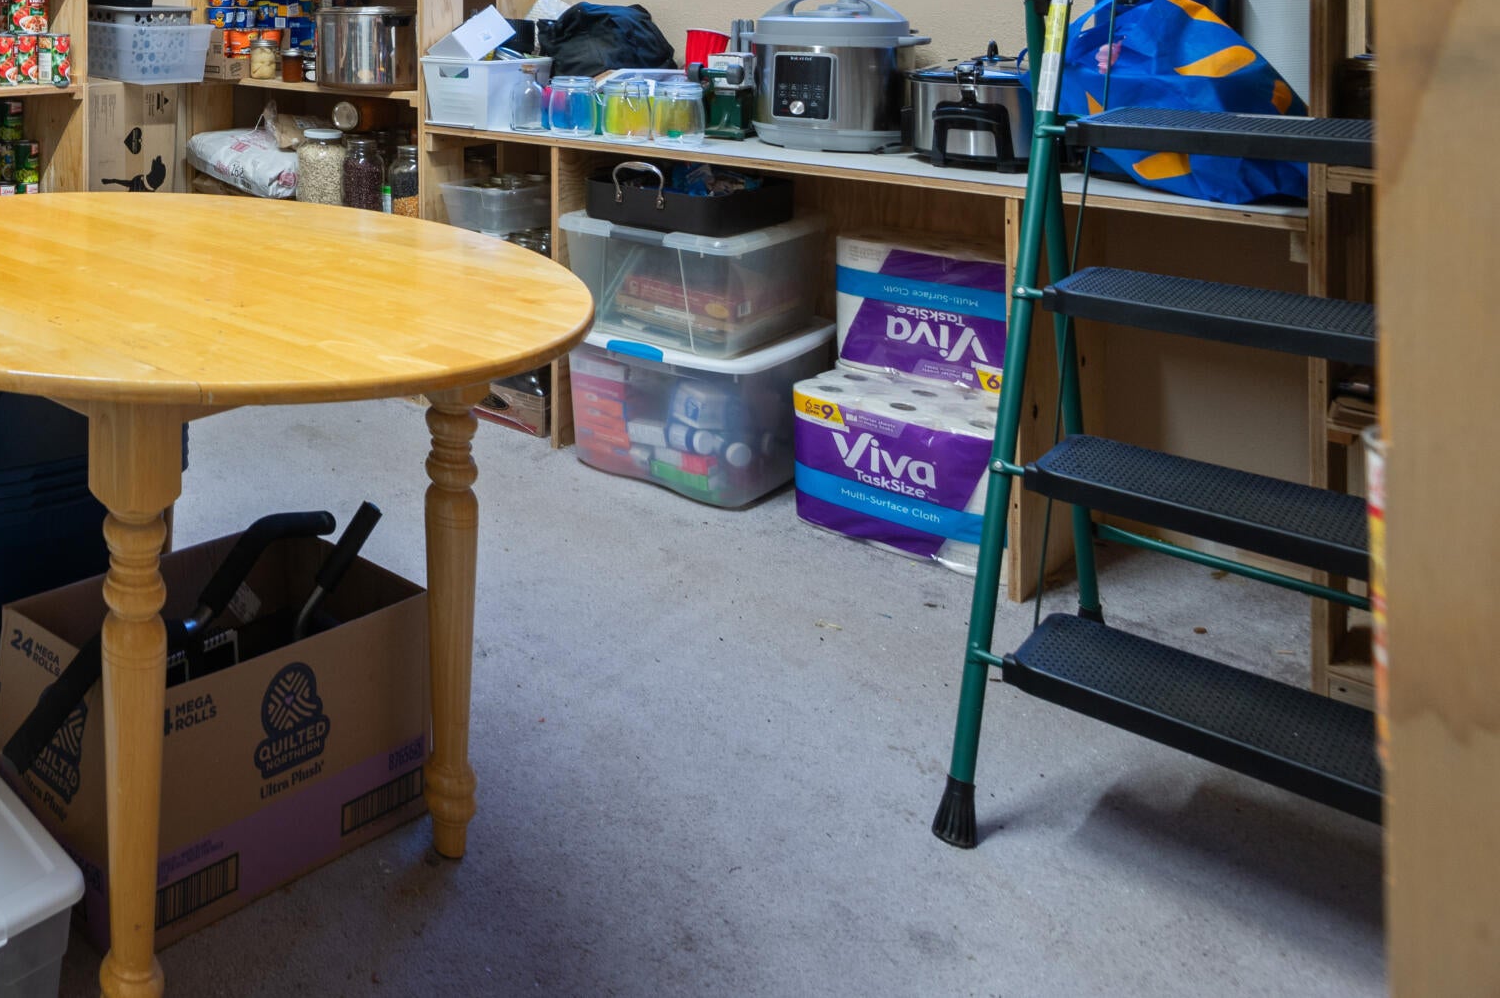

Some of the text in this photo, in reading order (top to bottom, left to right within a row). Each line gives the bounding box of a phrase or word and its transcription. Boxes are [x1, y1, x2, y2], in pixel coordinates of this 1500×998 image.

[883, 285, 979, 307] Multi-Surface Cloth
[897, 305, 966, 327] TaskSize
[886, 315, 988, 362] Viva
[832, 432, 936, 489] Viva
[855, 469, 926, 498] TaskSize
[841, 488, 940, 523] Multi-Surface Cloth
[10, 629, 60, 664] 24 MEGA
[32, 655, 61, 677] ROLLS
[175, 694, 213, 717] MEGA
[175, 706, 217, 732] ROLLS
[259, 722, 326, 763] QUILTED
[266, 739, 321, 771] NORTHERN
[260, 762, 322, 799] Ultra Plush
